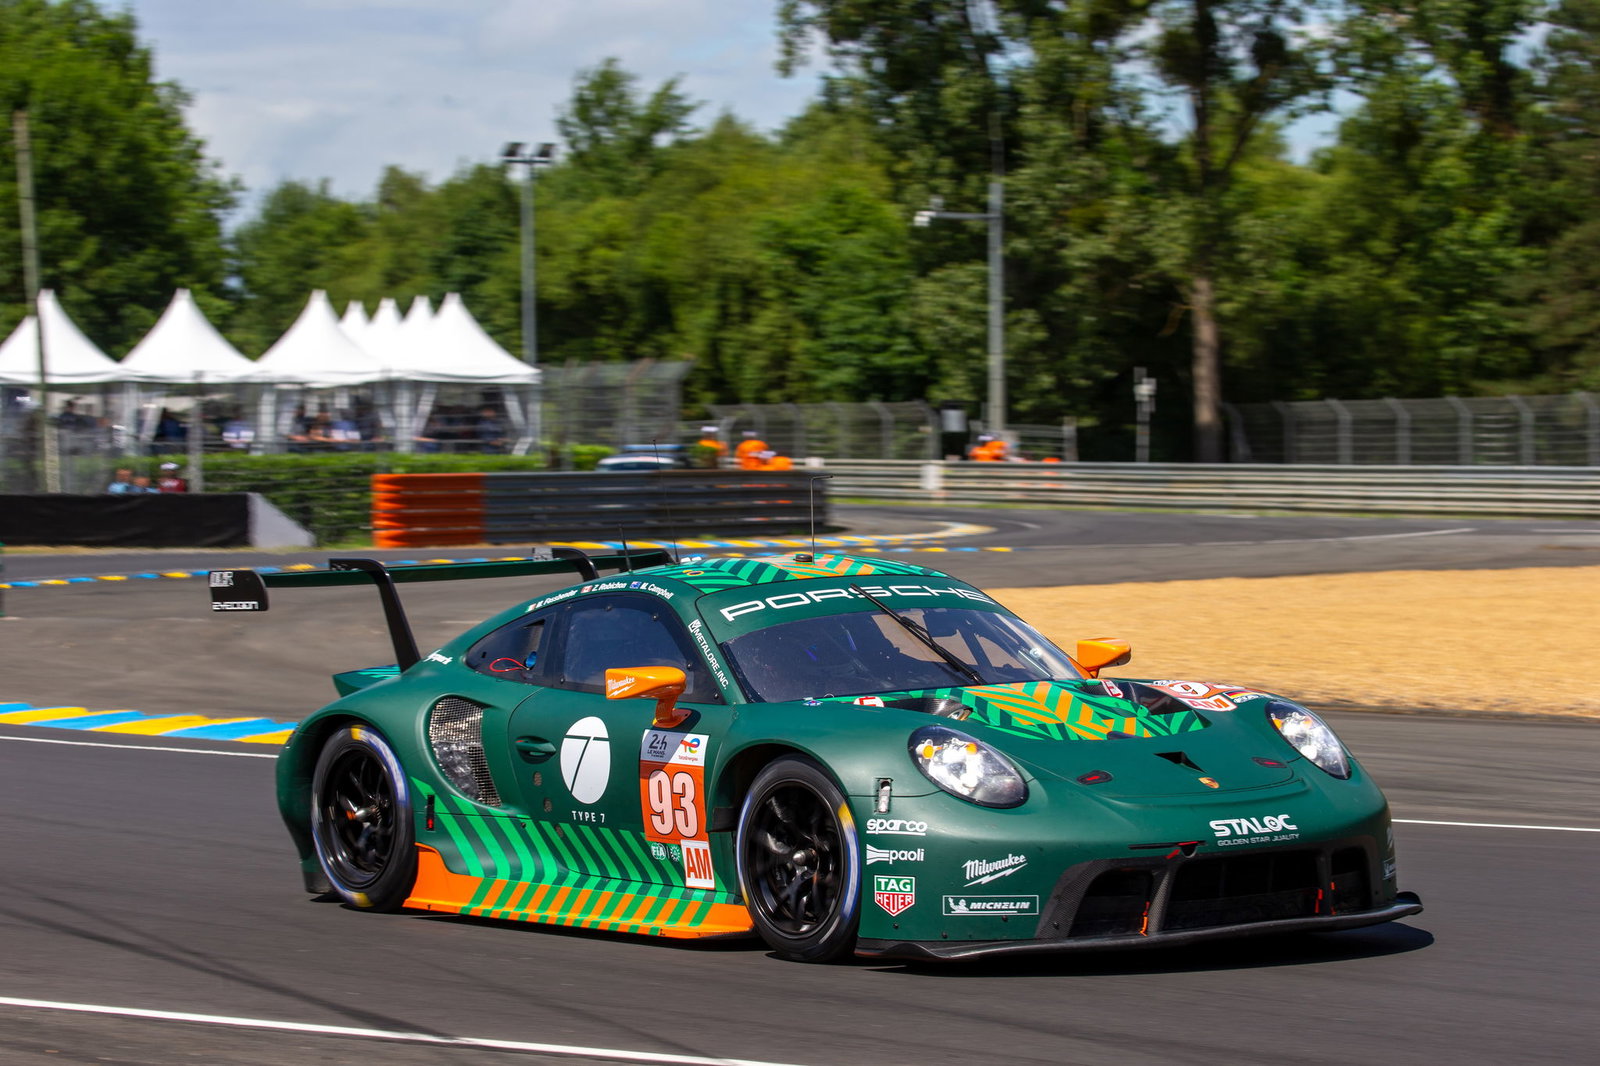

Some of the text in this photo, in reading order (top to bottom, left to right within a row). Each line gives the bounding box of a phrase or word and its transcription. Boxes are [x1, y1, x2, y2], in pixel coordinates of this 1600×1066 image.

[648, 584, 674, 600] Campbell
[720, 584, 996, 622] PORSCHE
[648, 770, 698, 838] 93
[572, 810, 605, 823] TYPE 7
[866, 818, 928, 834] sparco
[1209, 814, 1298, 836] STALOC
[1217, 838, 1249, 846] GOLDEN
[686, 847, 713, 881] AM
[889, 848, 924, 864] paoli
[961, 854, 1027, 880] Milwaukee
[877, 878, 911, 891] TAG
[876, 894, 912, 912] HEUER
[970, 902, 1030, 910] MICHELIN
